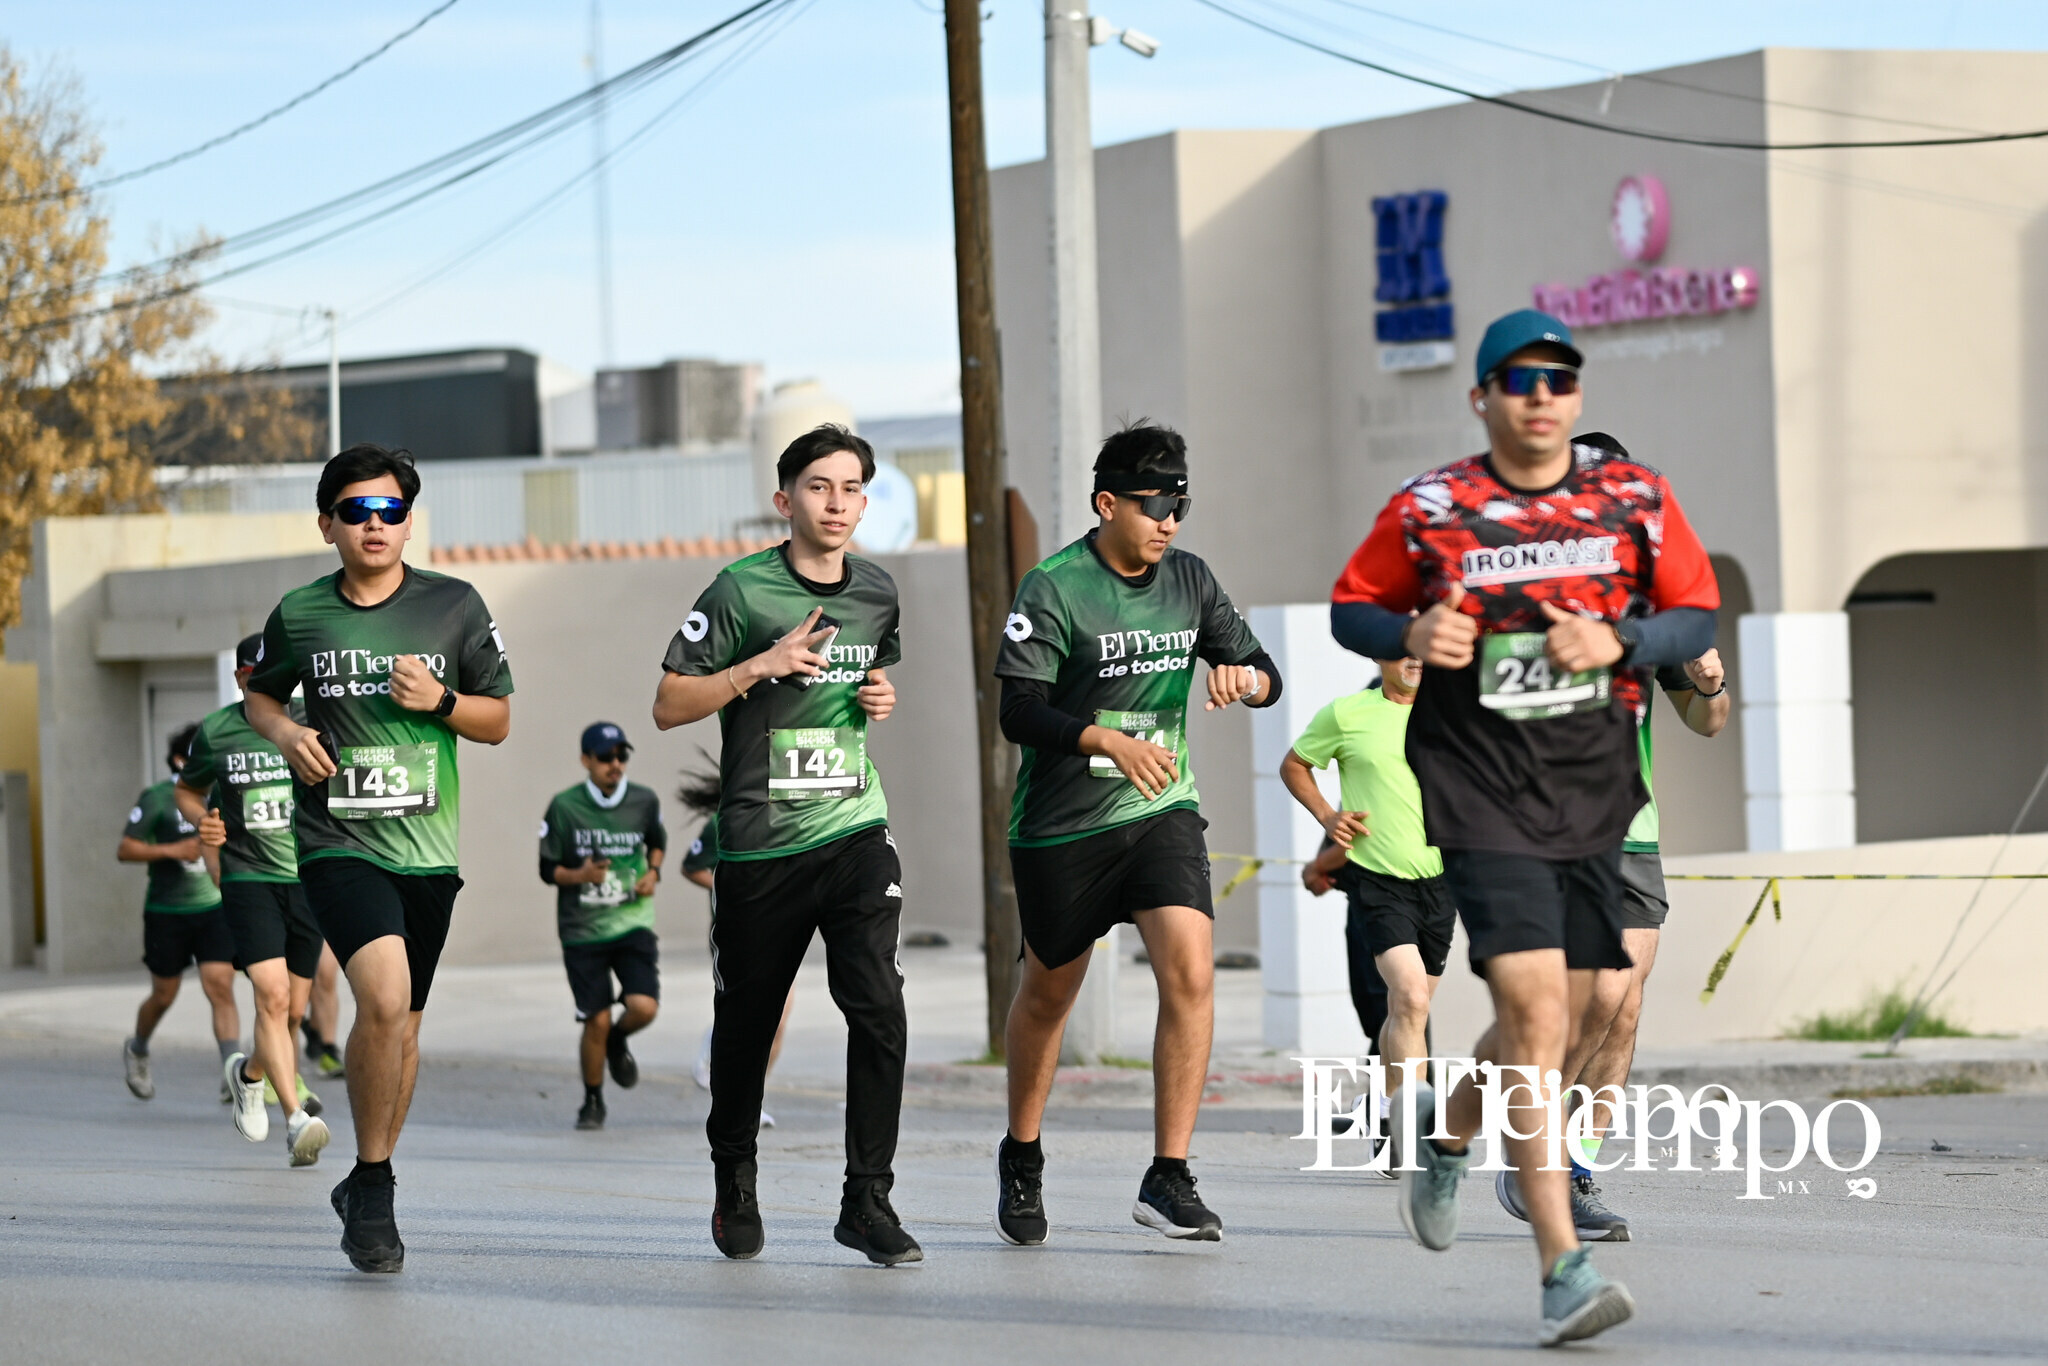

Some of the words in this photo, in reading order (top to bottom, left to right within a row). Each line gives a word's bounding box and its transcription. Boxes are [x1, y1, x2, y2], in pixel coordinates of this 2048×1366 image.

[1465, 539, 1616, 574] IRONCAST
[1097, 631, 1127, 662] El
[311, 650, 339, 679] El
[812, 666, 866, 684] odos
[1098, 663, 1129, 678] de
[1130, 654, 1190, 675] todos
[318, 680, 345, 698] de
[226, 753, 247, 772] El
[785, 747, 846, 778] 142
[858, 742, 866, 790] MEDALLA
[228, 772, 251, 784] de
[342, 765, 410, 797] 143
[426, 758, 436, 807] MEDALLA
